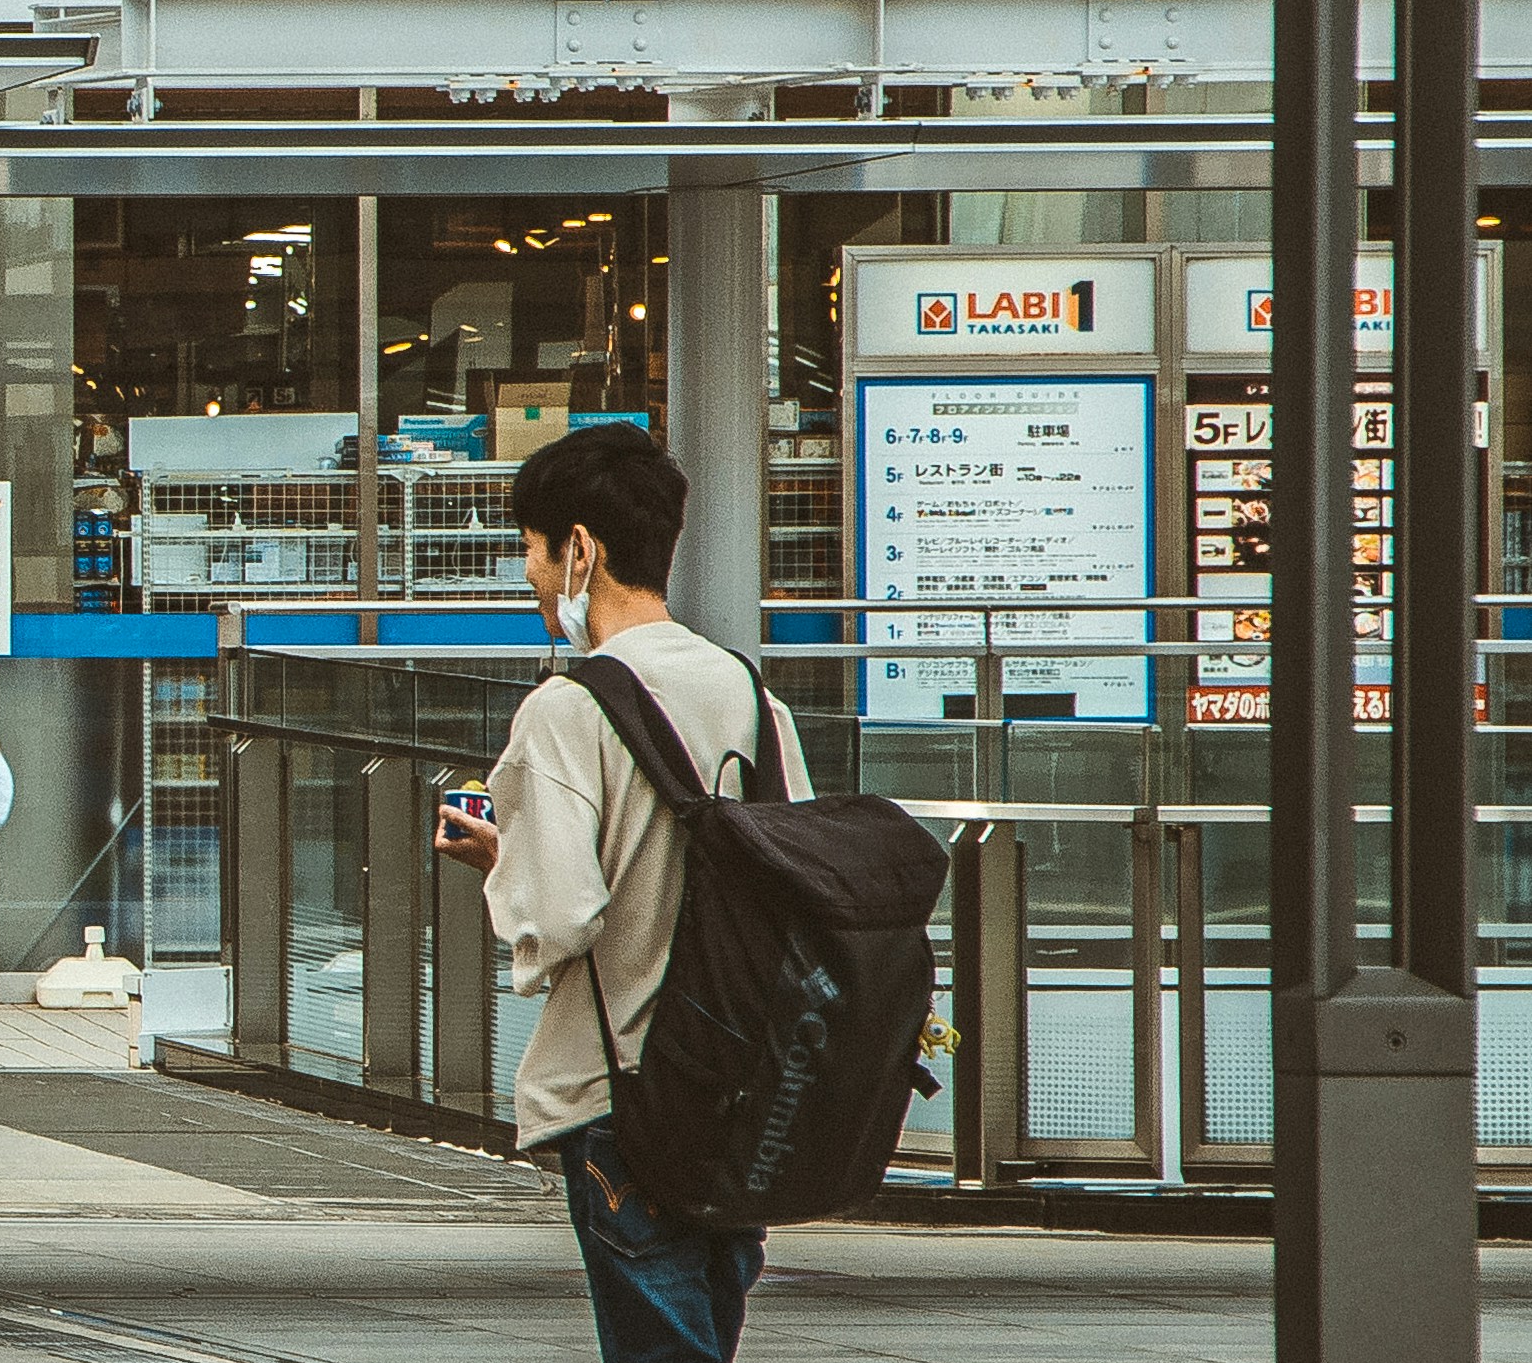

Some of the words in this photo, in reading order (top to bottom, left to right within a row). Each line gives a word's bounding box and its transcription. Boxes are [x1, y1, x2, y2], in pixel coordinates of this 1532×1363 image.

[967, 323, 1059, 335] TAKASAKI
[886, 467, 904, 483] 5F
[915, 463, 1004, 477] レストラン街
[887, 506, 904, 522] 4F
[887, 545, 904, 561] 3F
[887, 624, 904, 639] 1F
[886, 663, 906, 679] B1
